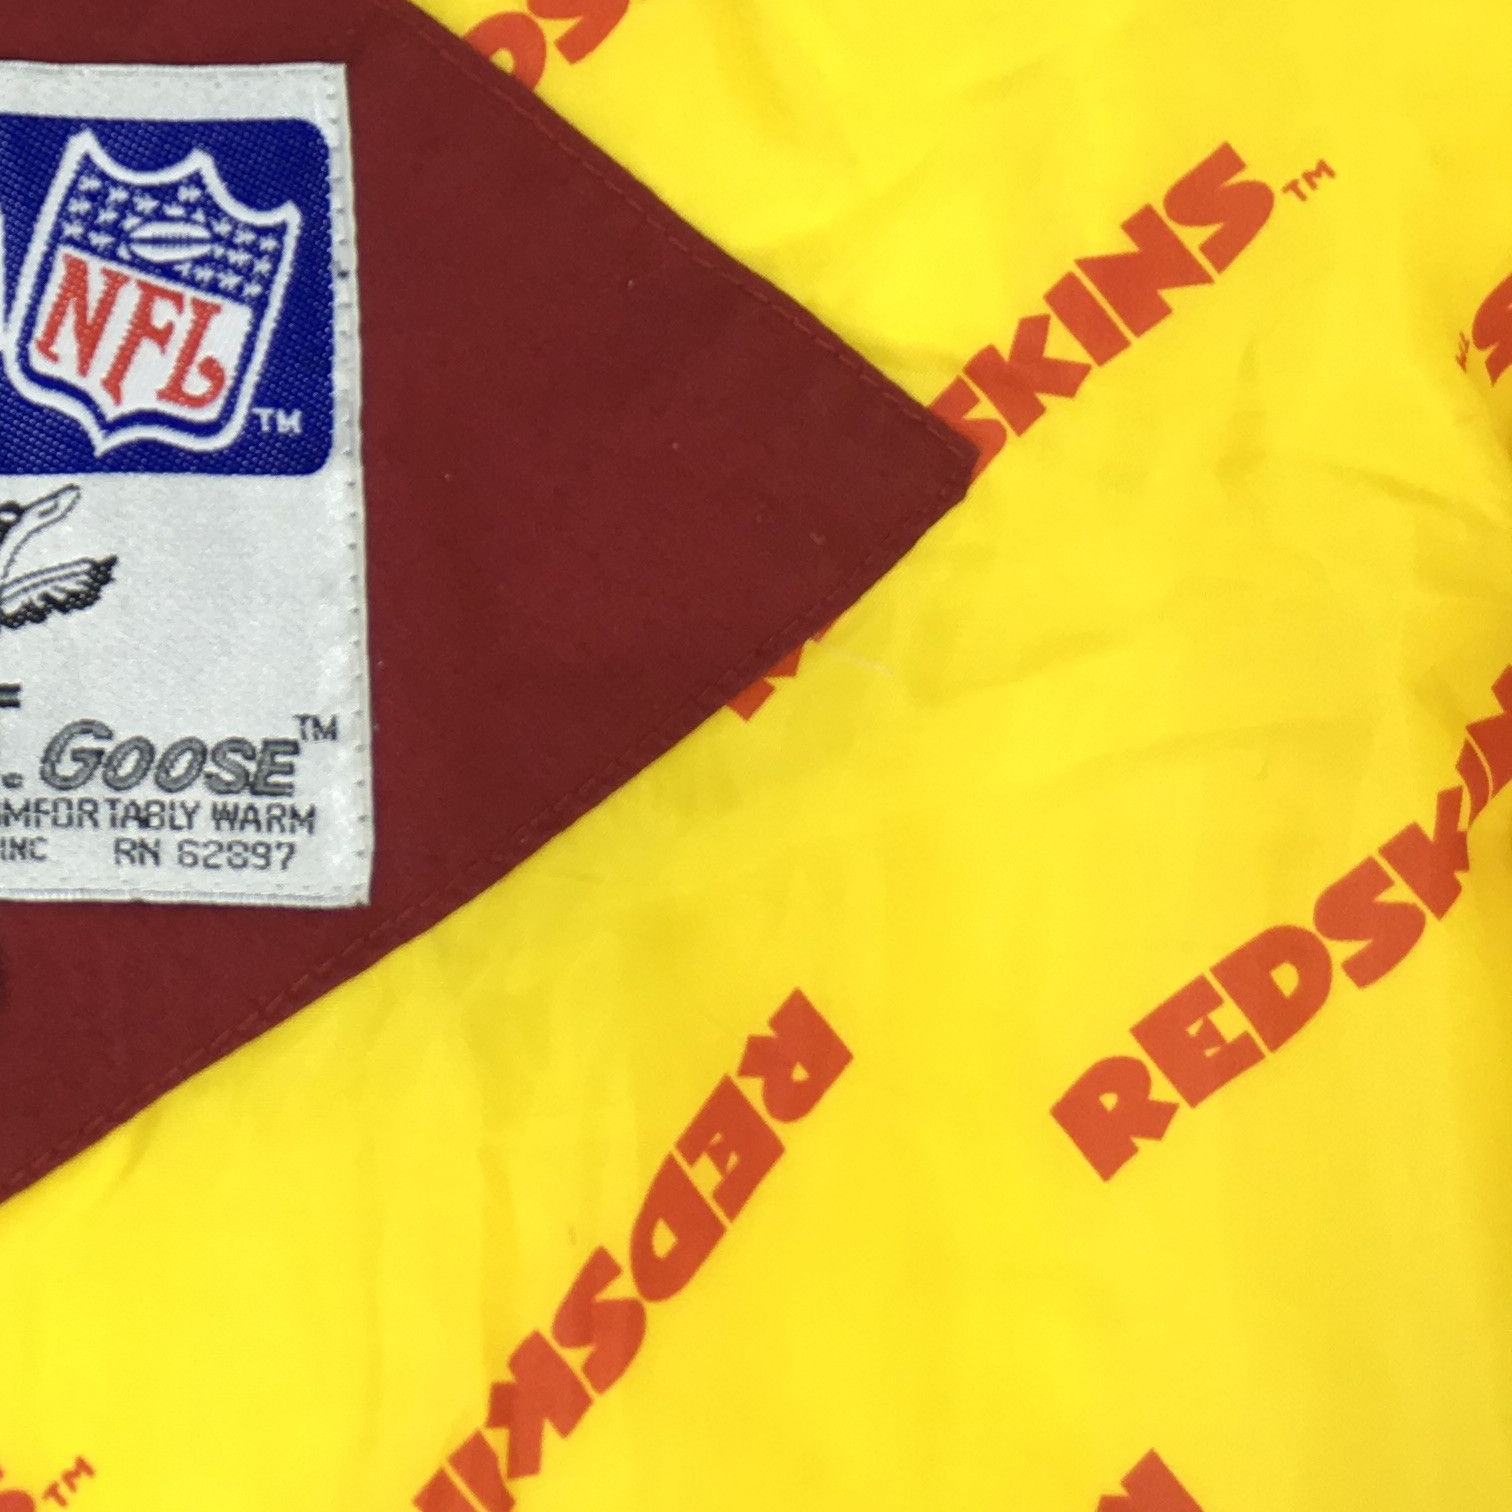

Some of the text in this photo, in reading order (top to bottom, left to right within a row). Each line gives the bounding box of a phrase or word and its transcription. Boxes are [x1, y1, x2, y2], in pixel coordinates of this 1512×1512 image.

[34, 251, 226, 410] NFL
[210, 803, 317, 835] WARM
[0, 836, 48, 862] INC
[114, 838, 161, 867] RN
